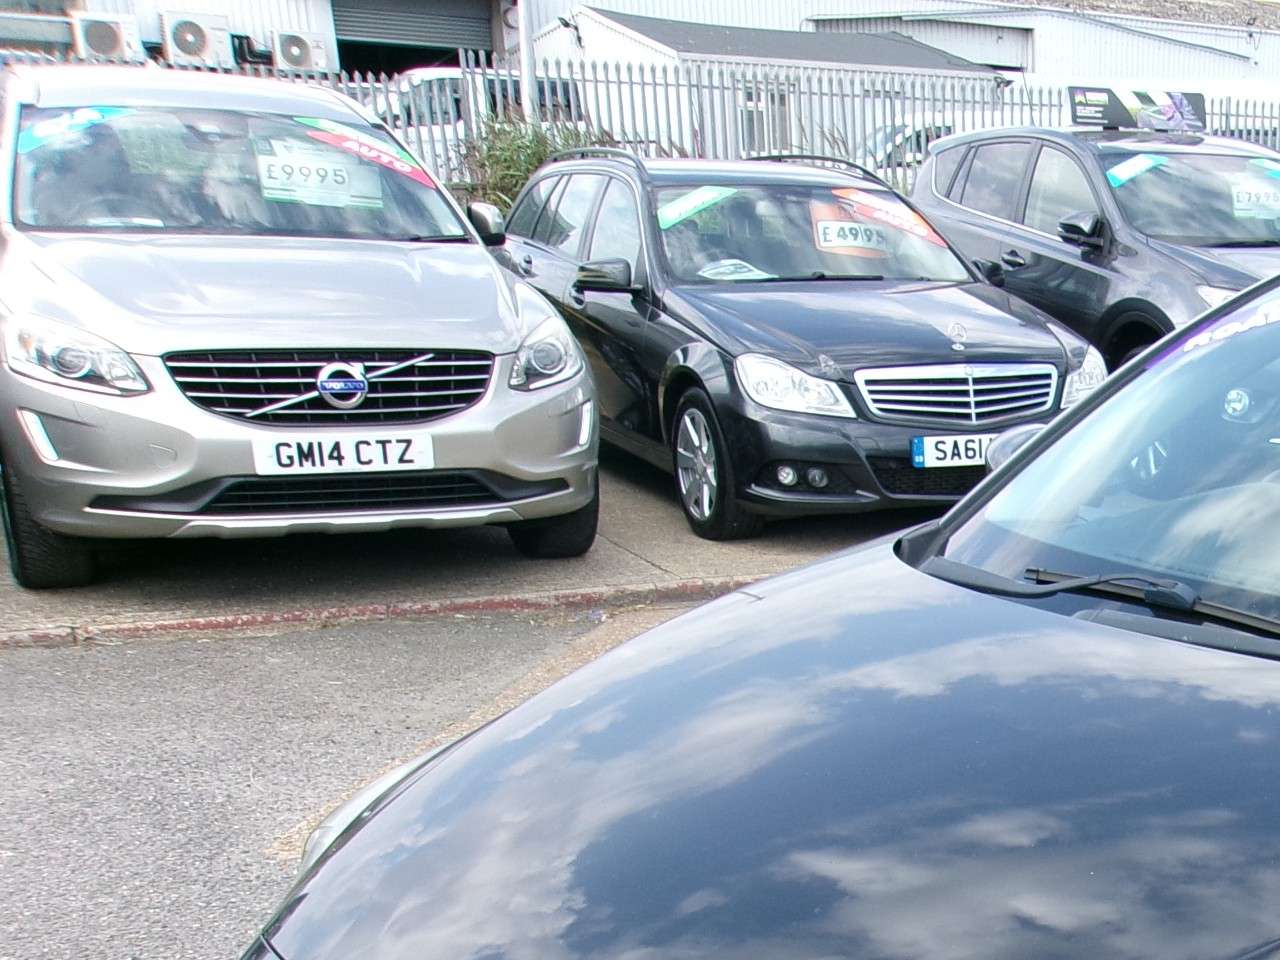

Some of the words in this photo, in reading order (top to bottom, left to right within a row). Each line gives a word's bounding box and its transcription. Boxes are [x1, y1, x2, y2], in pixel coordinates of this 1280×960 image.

[266, 164, 347, 185] £9995
[322, 382, 365, 390] VOLVO
[275, 441, 345, 468] GM14
[355, 439, 415, 465] CTZ
[934, 438, 983, 461] SA61
